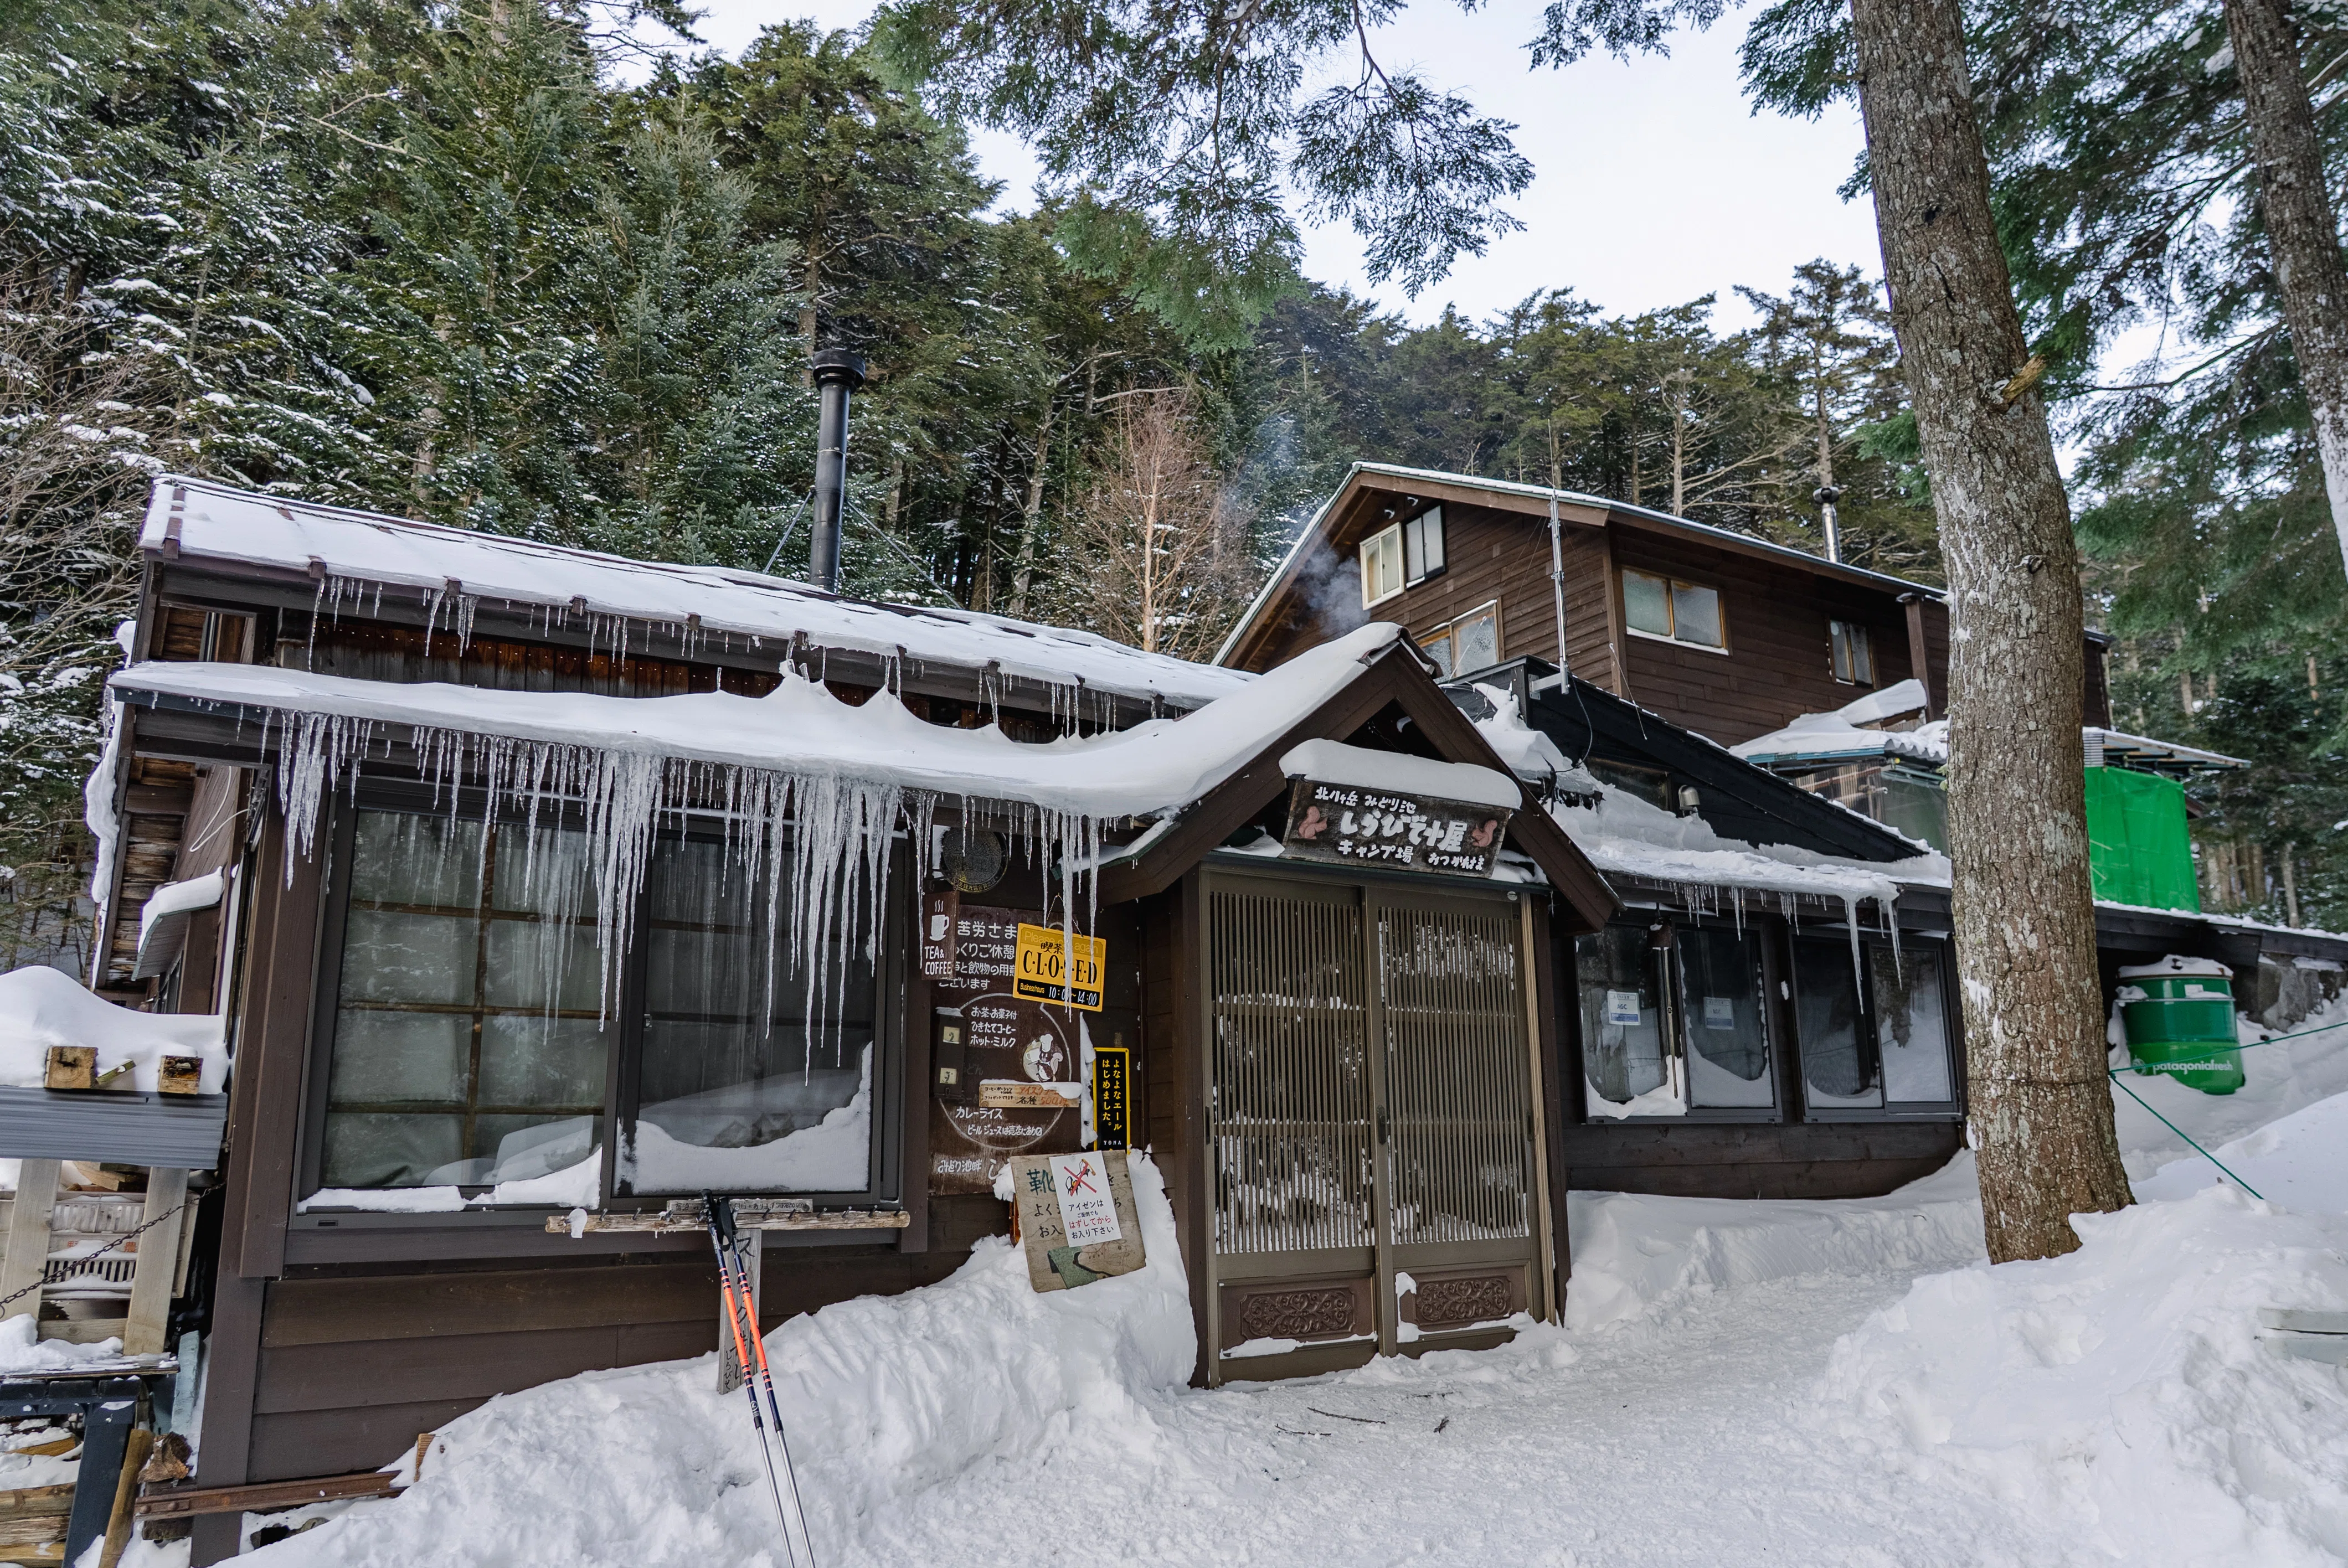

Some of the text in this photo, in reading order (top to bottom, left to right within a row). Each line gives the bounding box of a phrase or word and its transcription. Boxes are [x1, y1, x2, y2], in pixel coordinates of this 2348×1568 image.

[1364, 795, 1417, 814] みどり池
[1340, 810, 1468, 852] しらびそ小屋
[1337, 839, 1414, 864] キャンプ場
[924, 946, 945, 960] TEA&
[1041, 941, 1063, 955] 喫茶
[925, 961, 952, 976] COFFEE
[939, 977, 990, 991] ございます
[971, 1021, 1016, 1034] ひきたてコーヒー
[970, 1034, 1016, 1048] ホット・ミルク
[1102, 1059, 1112, 1127] はじめました。
[1113, 1059, 1122, 1131] よなよなエール
[1016, 1096, 1037, 1105] 各種
[955, 1106, 1003, 1120] カレーライス
[967, 1124, 982, 1136] ビール
[937, 1158, 982, 1173] みどり池畔
[1068, 1199, 1104, 1212] アイゼンは
[1069, 1215, 1111, 1229] はずしてから
[1071, 1225, 1114, 1239] お入り下さい
